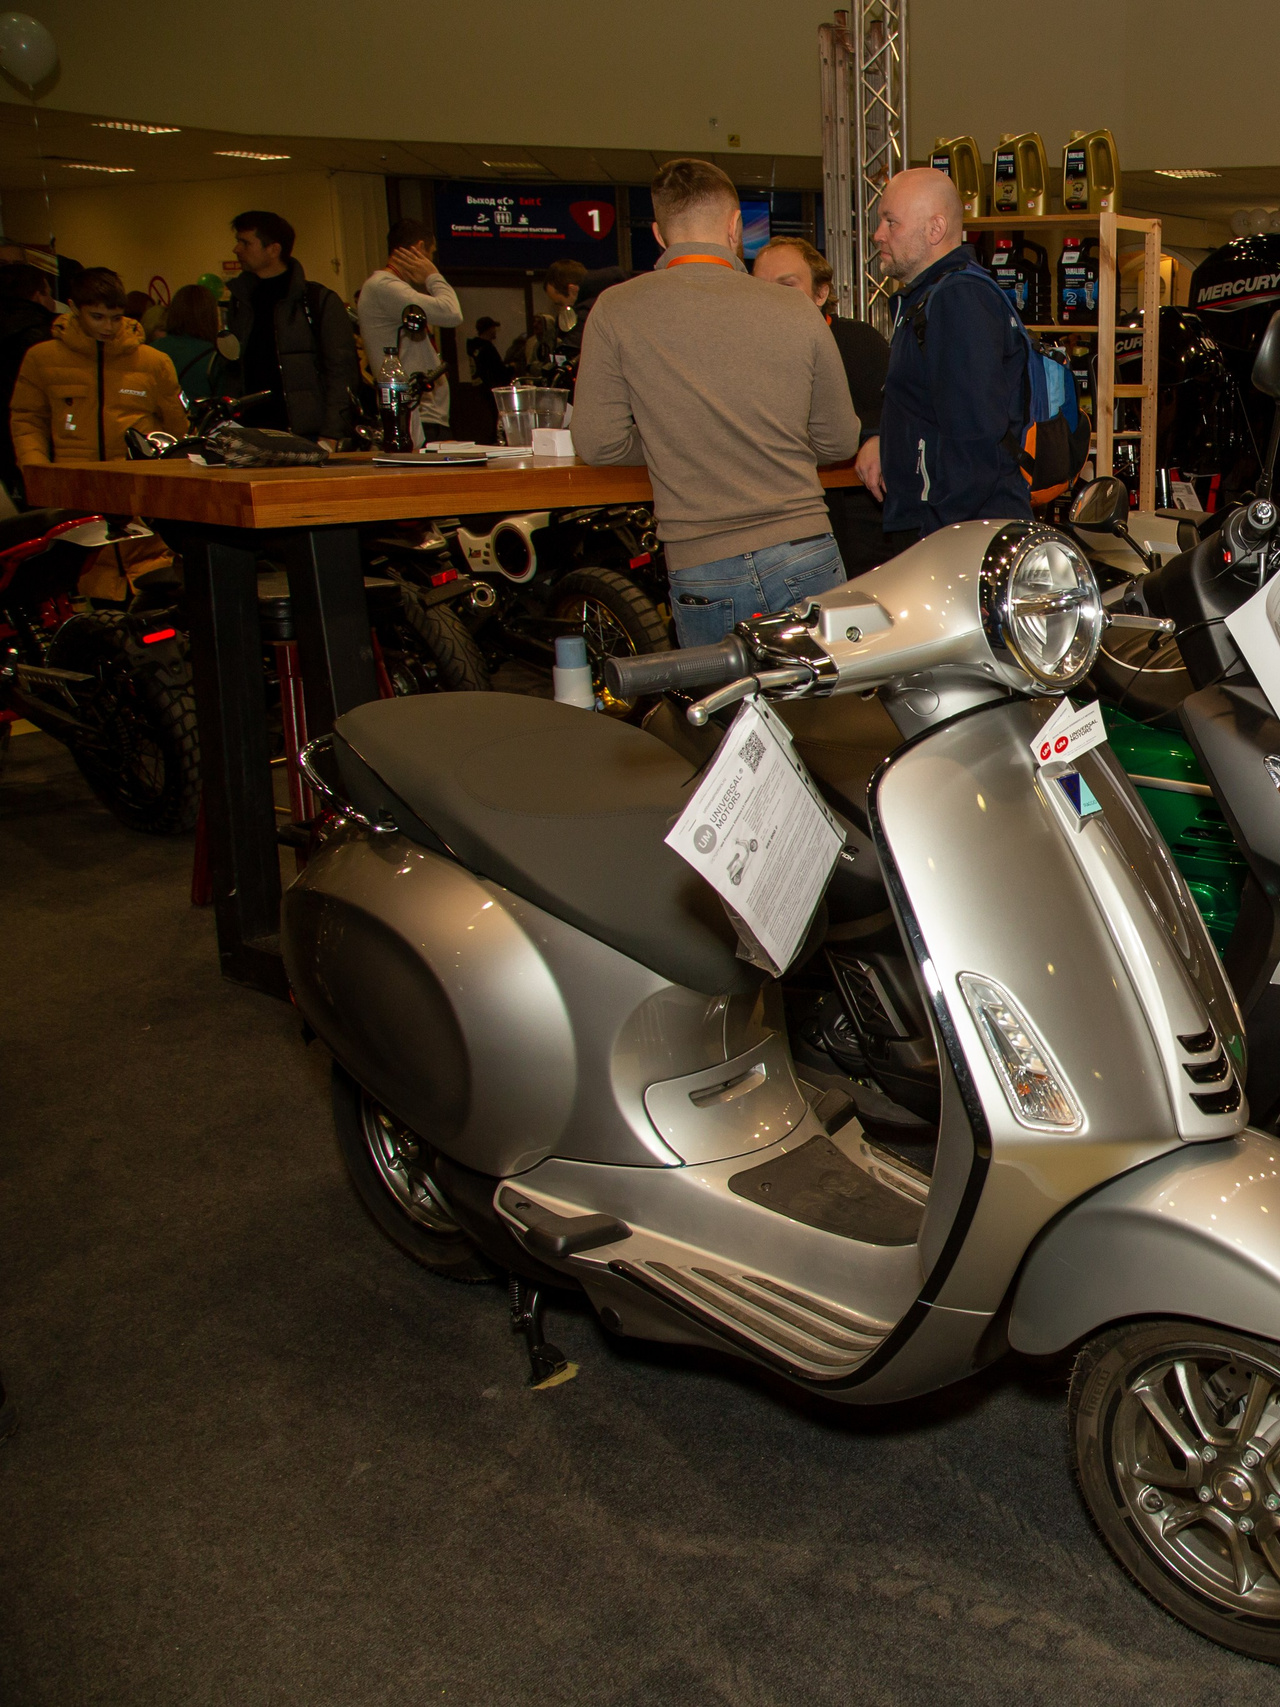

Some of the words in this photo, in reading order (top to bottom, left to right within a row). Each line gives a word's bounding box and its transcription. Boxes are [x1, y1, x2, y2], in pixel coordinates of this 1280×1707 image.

[466, 195, 496, 206] Выход
[587, 209, 600, 232] 1
[1065, 291, 1078, 306] 2
[1069, 719, 1098, 738] UNIVERSAL
[1070, 728, 1093, 743] MOTORS
[1056, 740, 1067, 750] UM
[709, 774, 743, 825] UNIVERSAL
[715, 790, 741, 830] MOTORS
[698, 829, 713, 848] UM
[1078, 1366, 1111, 1418] PIRELLI
